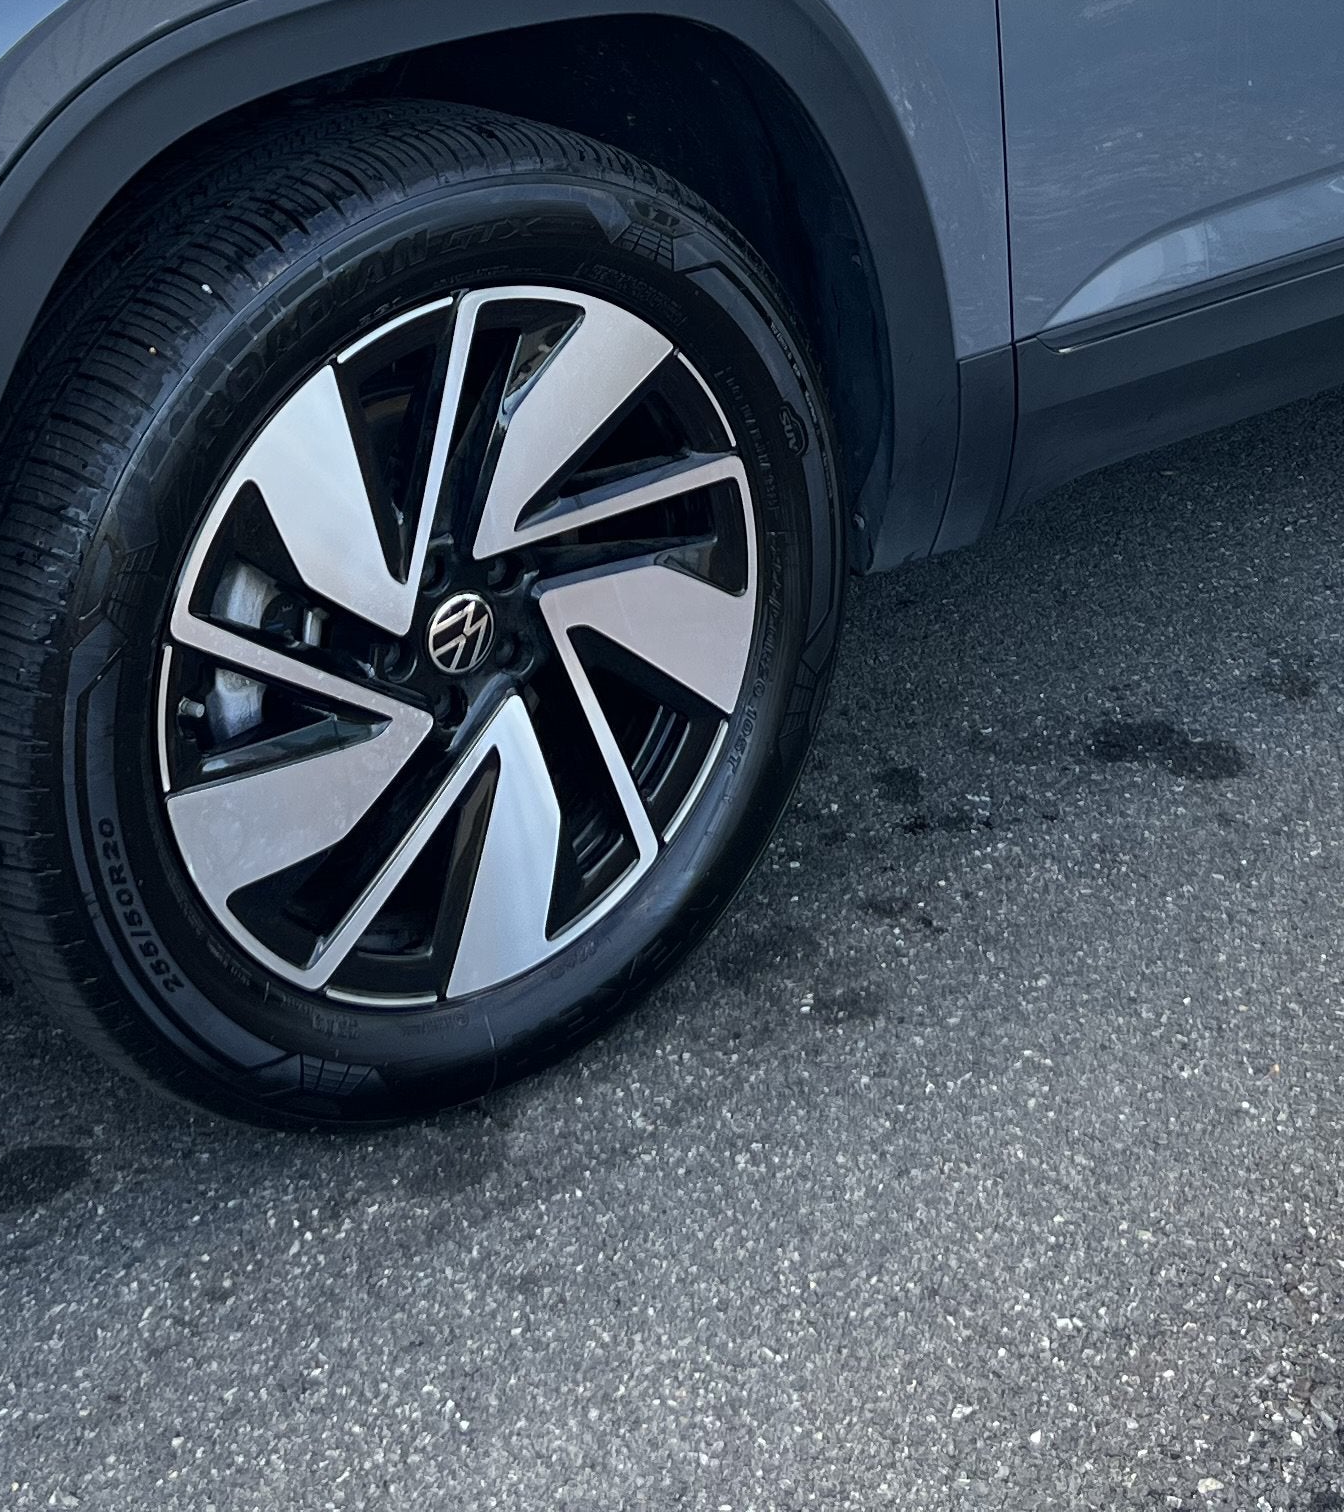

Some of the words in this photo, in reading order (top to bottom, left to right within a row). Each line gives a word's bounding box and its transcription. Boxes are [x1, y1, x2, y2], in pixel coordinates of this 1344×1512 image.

[186, 226, 430, 454] ROADIAN
[439, 216, 541, 256] GTX
[777, 409, 799, 455] SUV
[97, 816, 185, 994] 255/50R20
